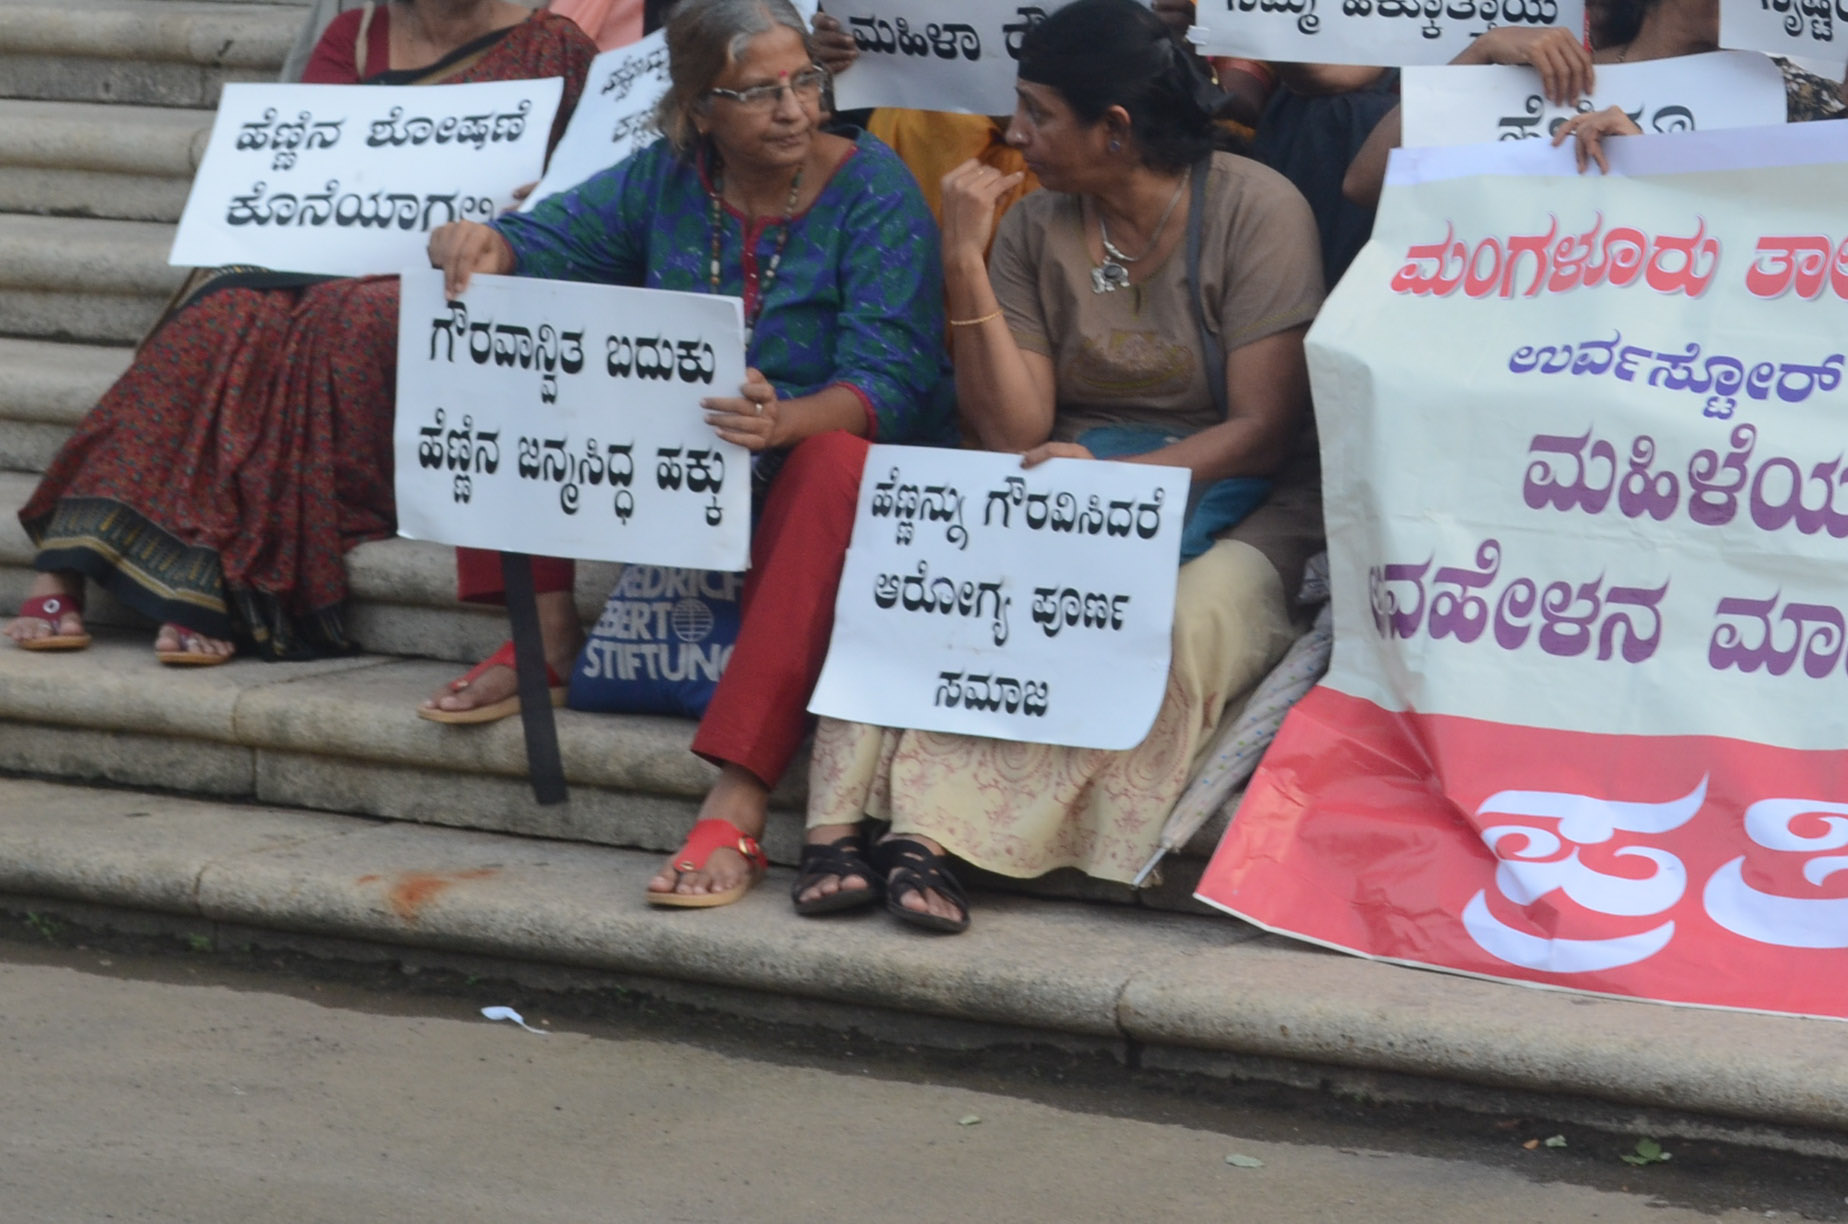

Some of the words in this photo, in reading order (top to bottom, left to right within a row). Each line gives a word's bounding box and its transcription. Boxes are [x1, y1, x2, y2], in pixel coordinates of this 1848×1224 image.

[849, 16, 981, 61] ಮಹಿಳಾ
[366, 99, 532, 151] ಶೋಷಣೆ
[1390, 208, 1721, 300] ಮಂಗಳೂರು
[430, 300, 585, 404] ಗೌರವಾನ್ವಿತ
[606, 334, 716, 385] ಬದುಕು
[518, 436, 634, 525] ಜನ್ಮಸಿದ್ಧ
[655, 446, 726, 526] ಹಕ್ಕು
[871, 466, 968, 550] ಹೆಣ್ಣನ್ನು
[983, 476, 1165, 540] ಗೌರವಿಸಿದರೆ
[1032, 586, 1130, 637] ಪೂರ್ಣ
[934, 671, 1049, 717] ಸಮಾಜ
